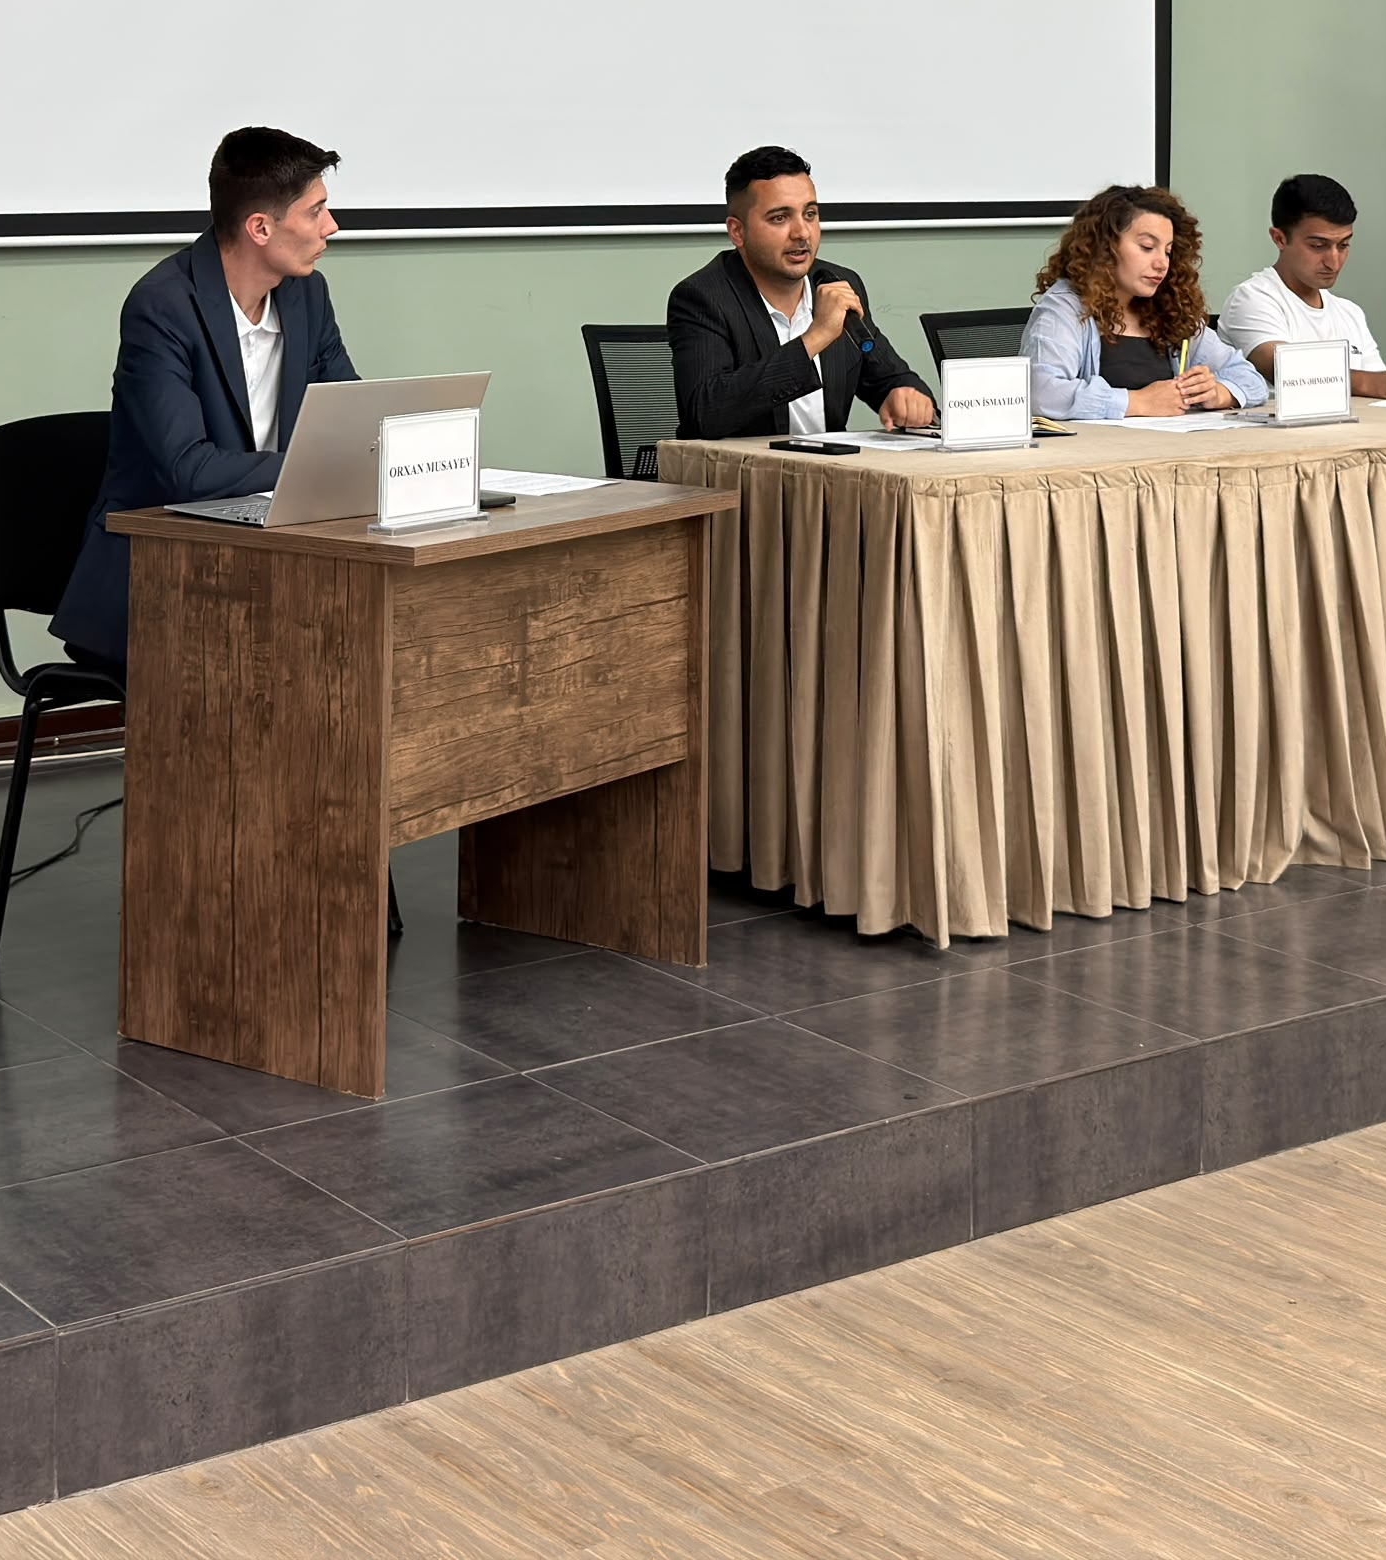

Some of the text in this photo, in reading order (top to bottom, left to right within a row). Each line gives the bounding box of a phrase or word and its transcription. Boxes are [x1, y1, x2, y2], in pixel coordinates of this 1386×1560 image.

[948, 396, 1026, 409] COŞQUN İSMAYILOV
[389, 456, 472, 478] ORXAN MUSAYEV
